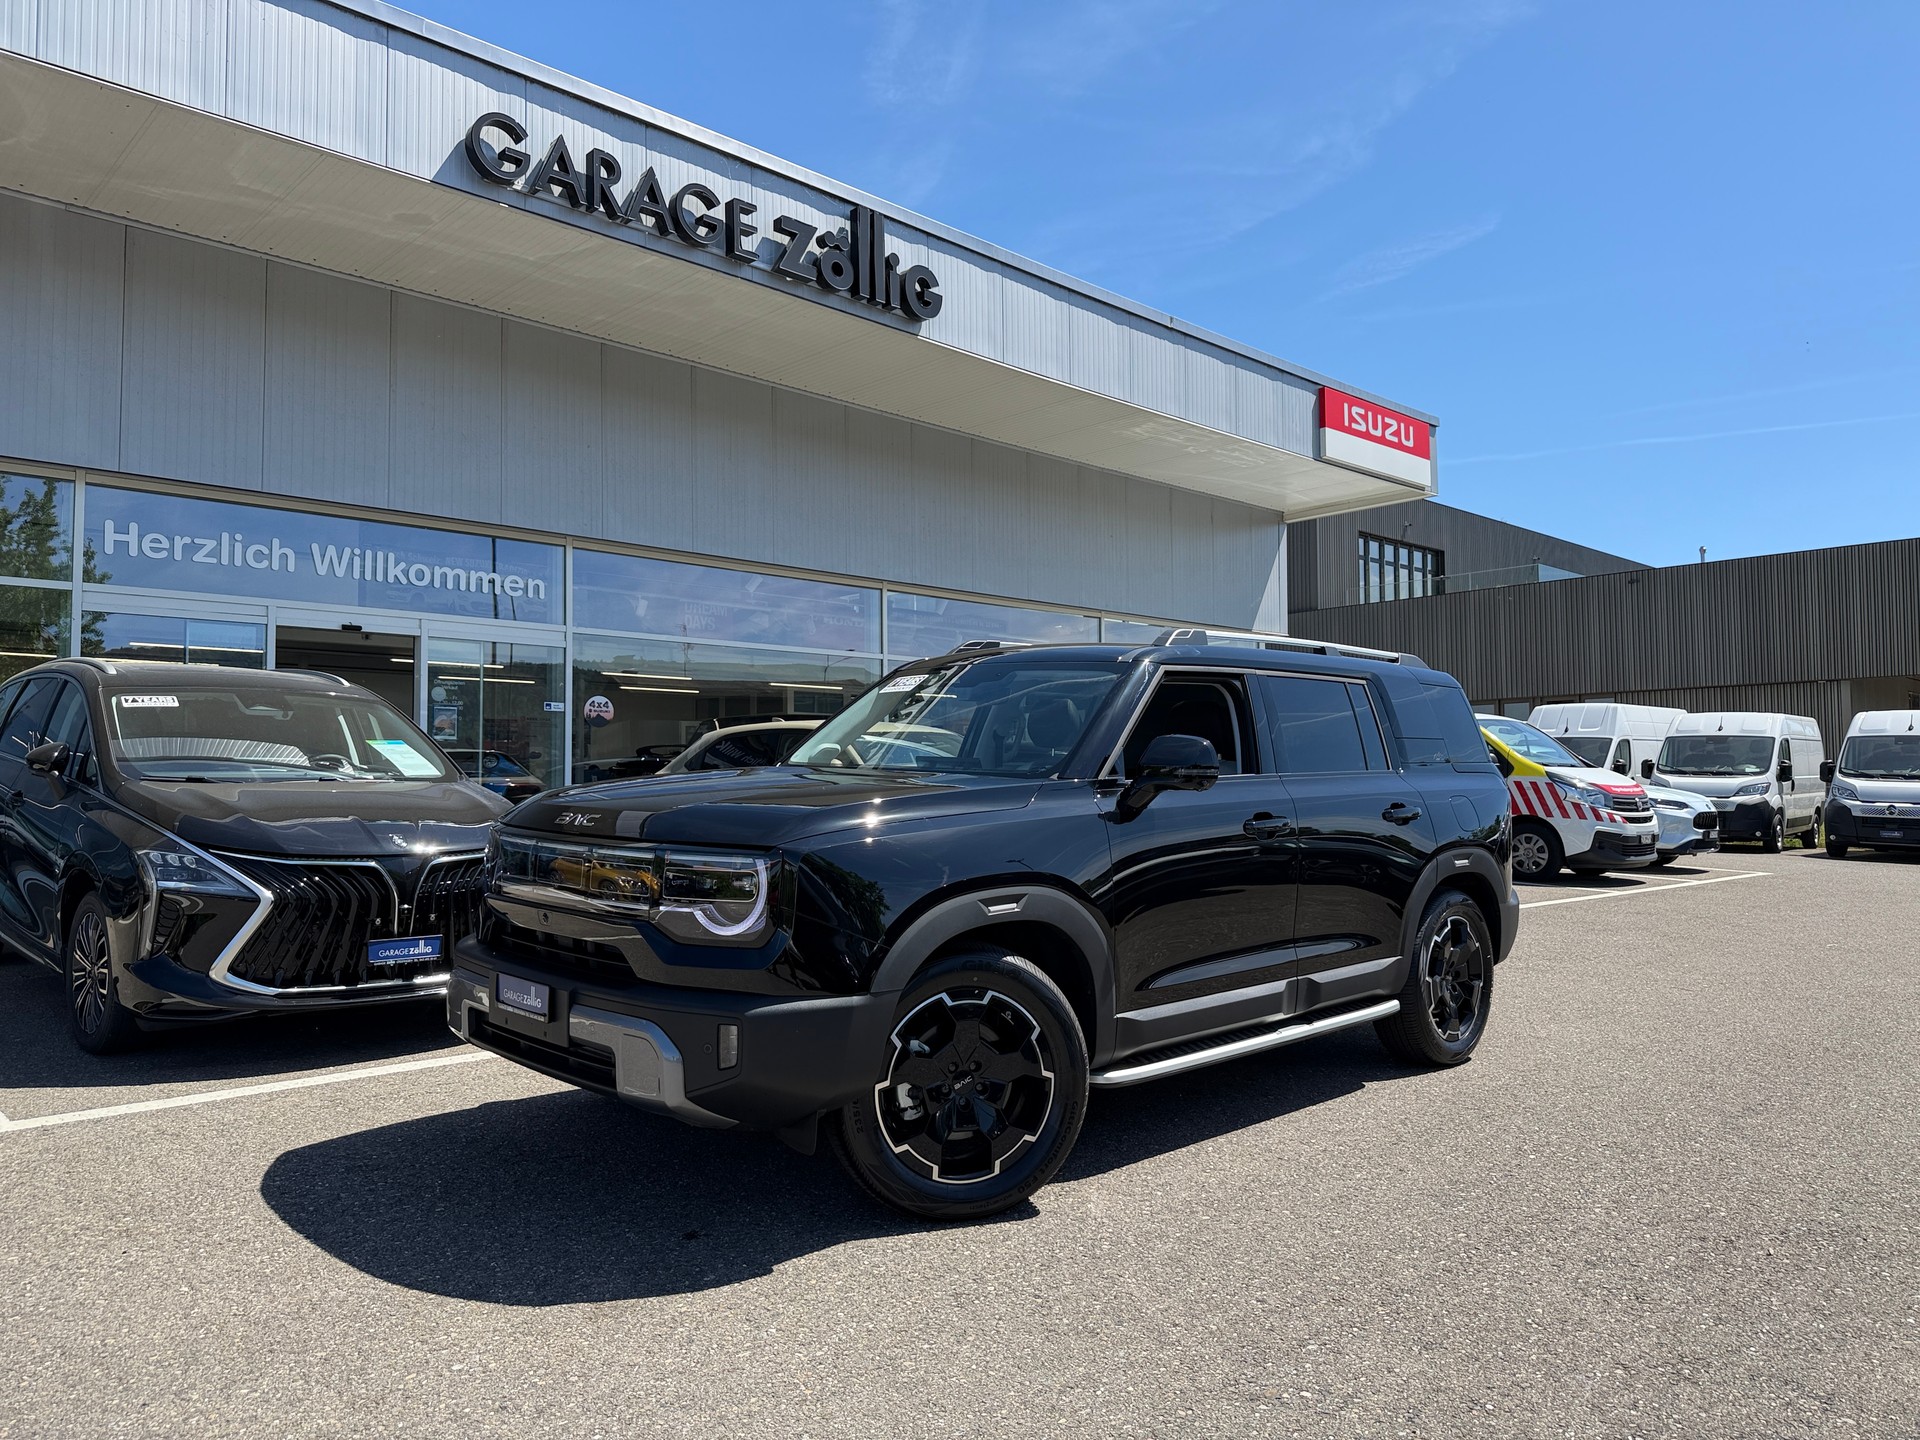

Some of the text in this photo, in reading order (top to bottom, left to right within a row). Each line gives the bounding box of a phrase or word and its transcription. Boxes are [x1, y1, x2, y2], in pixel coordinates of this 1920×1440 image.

[465, 112, 759, 263] GARAGE
[1344, 402, 1414, 448] ISUZU
[103, 519, 546, 600] Herzlich Willkommen
[588, 700, 610, 709] 4x4
[378, 948, 409, 957] GARAGE
[503, 988, 523, 1003] GARAGE
[953, 1075, 973, 1090] BAIC
